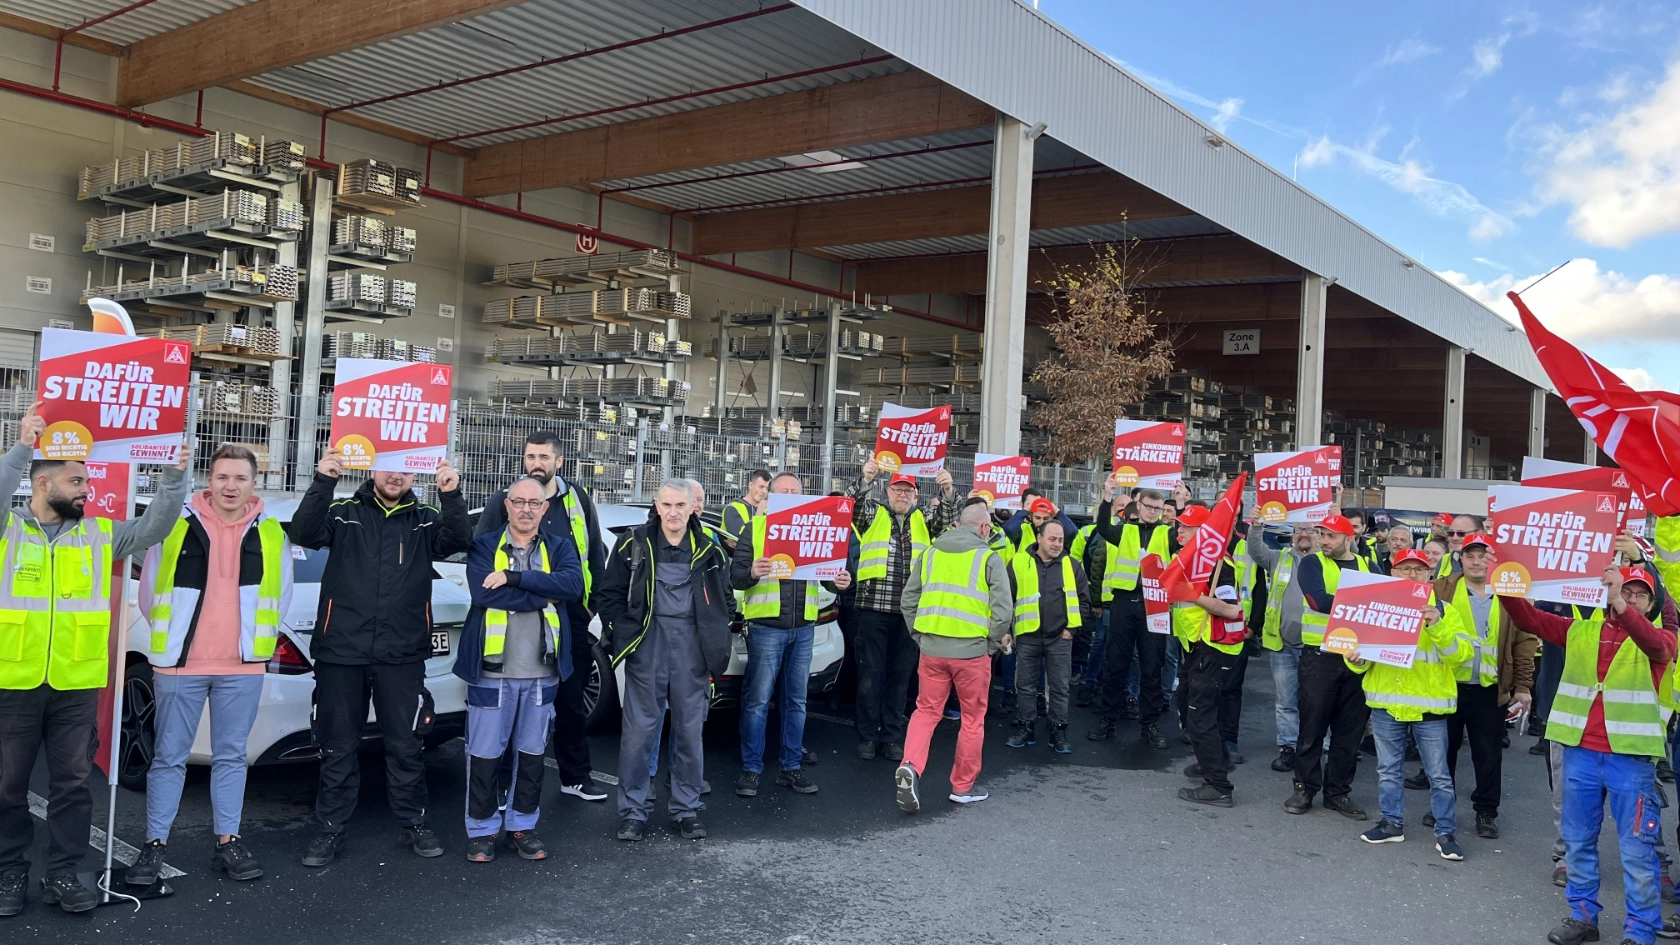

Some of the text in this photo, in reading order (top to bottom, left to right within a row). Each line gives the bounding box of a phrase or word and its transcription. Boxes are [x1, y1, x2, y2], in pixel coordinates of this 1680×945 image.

[1234, 343, 1249, 351] 3.A
[85, 361, 154, 382] DAFÜR
[43, 376, 184, 408] STREITEN
[368, 383, 422, 401] DAFÜR
[100, 404, 160, 430] WIR
[336, 397, 446, 423] STREITEN
[381, 420, 428, 443] WIR
[902, 422, 935, 433] DAFÜR
[880, 427, 947, 446] STREITEN
[906, 445, 936, 459] WIR
[1116, 446, 1180, 464] STÄRKEN!
[1142, 443, 1182, 451] EINKOMMEN
[976, 472, 1028, 484] STREITEN
[991, 465, 1016, 474] DAFÜR
[1278, 465, 1312, 477] DAFÜR
[996, 483, 1019, 494] WIR
[1259, 476, 1328, 490] STREITEN
[1288, 489, 1318, 503] WIR
[792, 512, 831, 526] DAFÜR
[1527, 511, 1586, 530] DAFÜR
[768, 524, 848, 542] STREITEN
[1496, 524, 1612, 553] STREITEN
[799, 542, 834, 558] WIR
[1538, 548, 1588, 573] WIR
[1369, 602, 1422, 617] EINKOMMEN
[1333, 604, 1420, 633] STÄRKEN!
